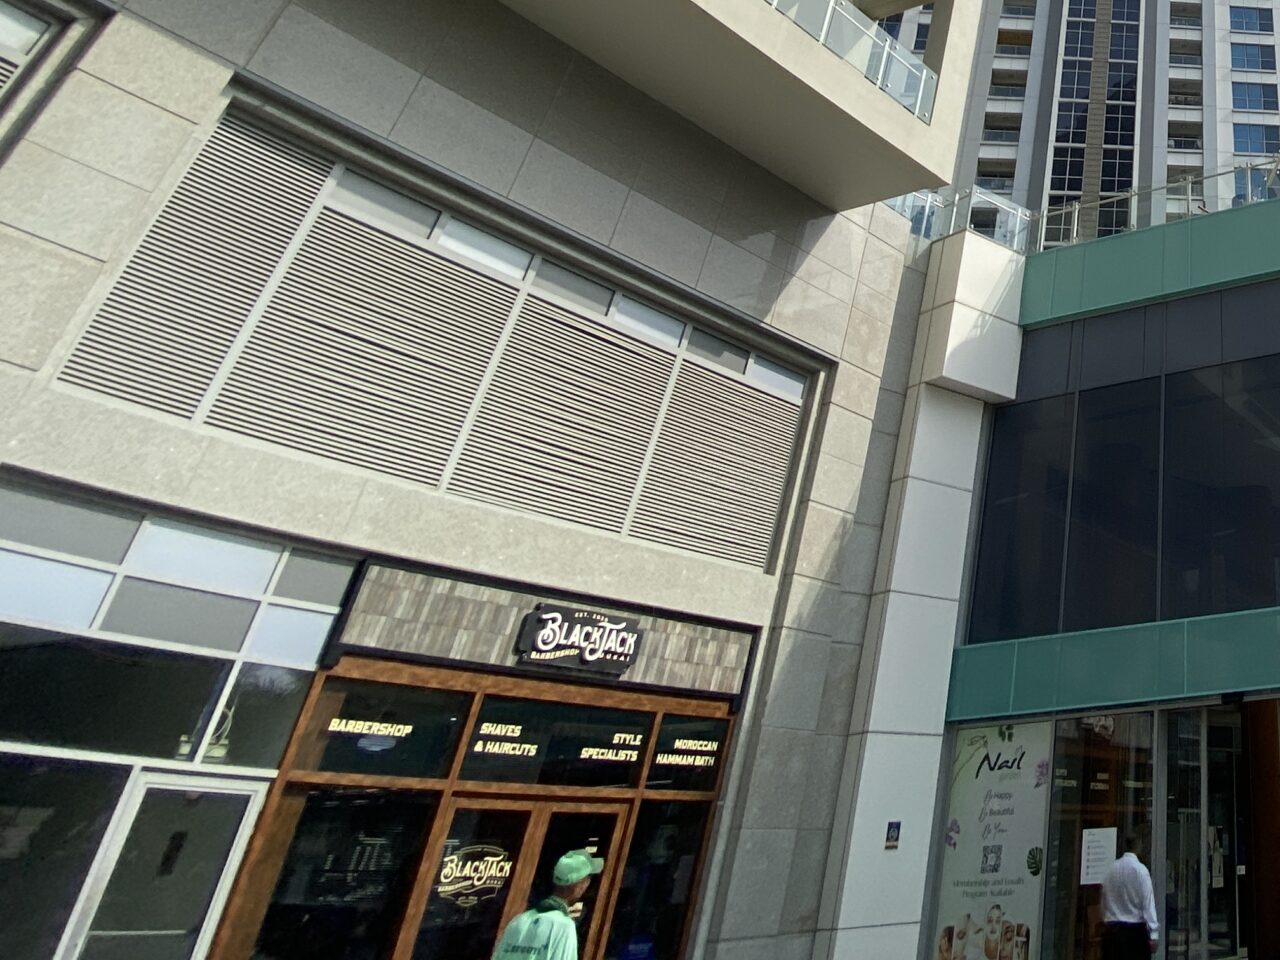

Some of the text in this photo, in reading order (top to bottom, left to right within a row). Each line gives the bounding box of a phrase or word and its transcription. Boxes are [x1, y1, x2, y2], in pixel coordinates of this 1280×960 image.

[530, 648, 580, 660] BARBERSHOP
[328, 718, 414, 737] BARBERSHOP
[479, 722, 523, 738] SHAVES
[612, 733, 643, 746] STYLE
[674, 739, 719, 752] MOROCCAN
[473, 740, 539, 757] & HAIRCUTS
[579, 747, 639, 762] SPECIALISTS
[656, 753, 715, 767] HAMMAM BATH
[974, 750, 1026, 780] Nail
